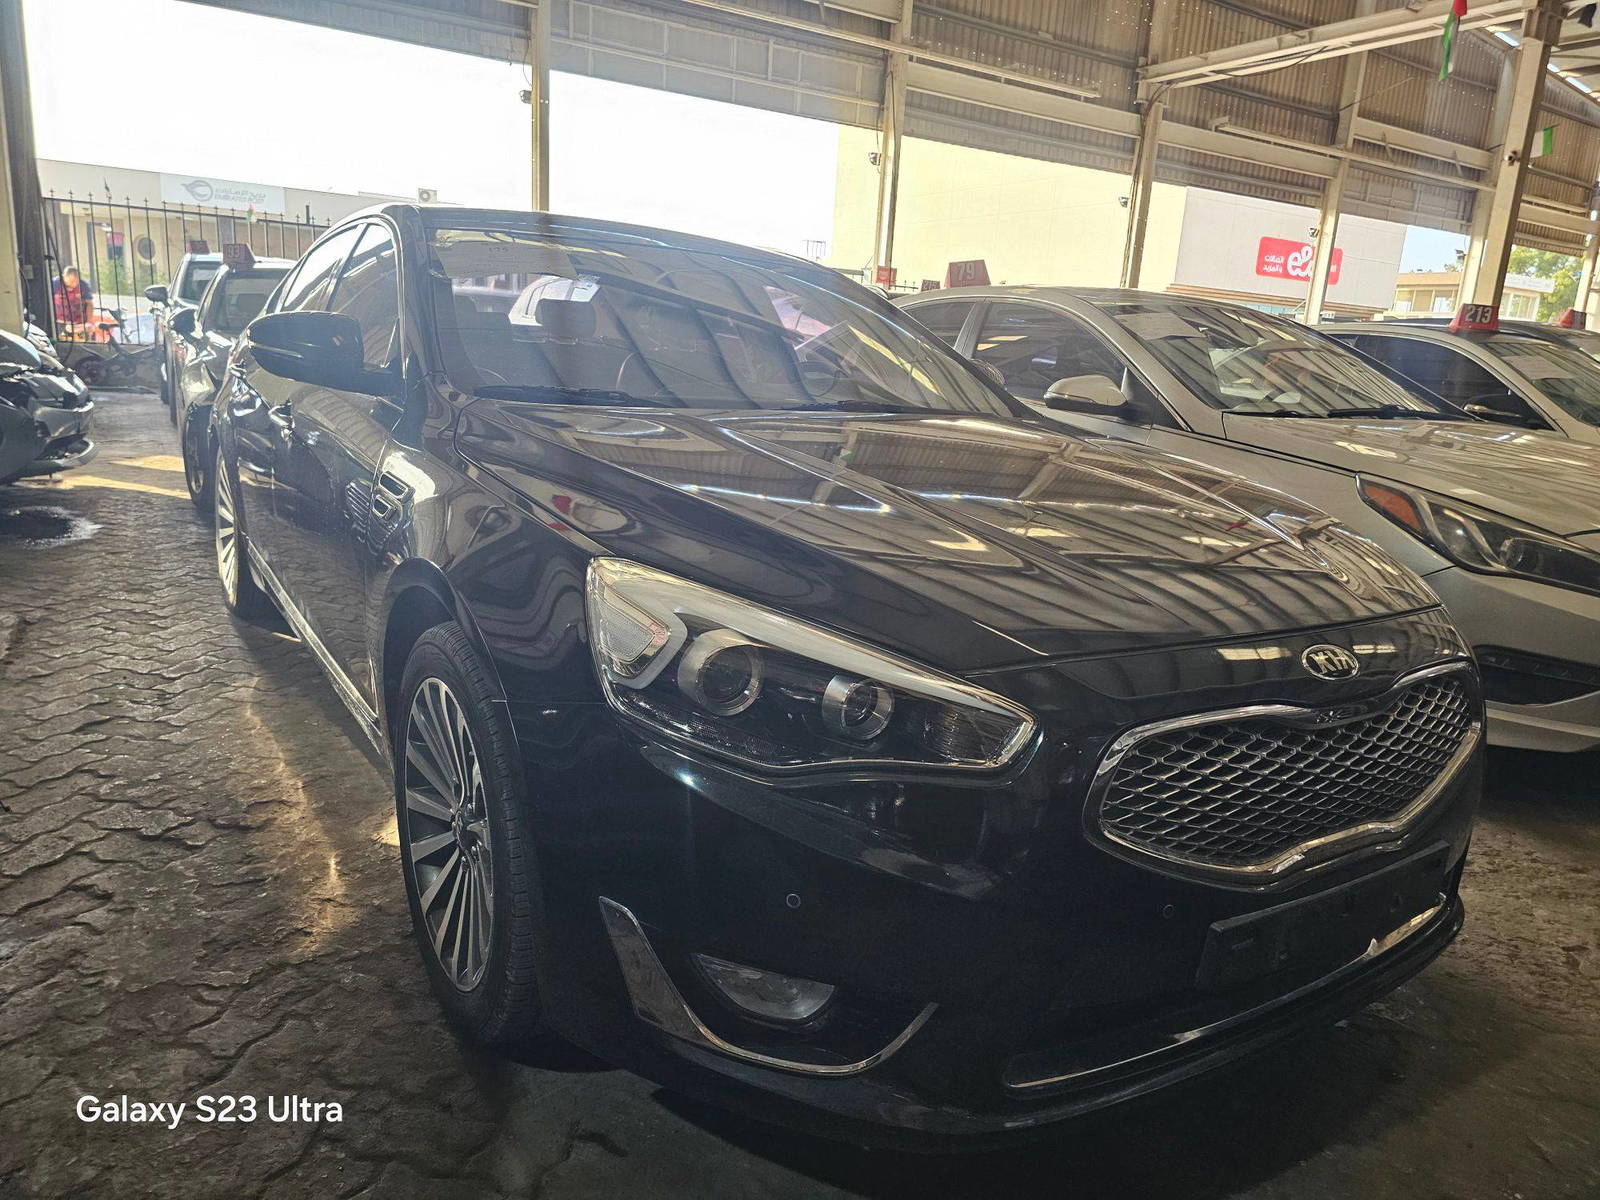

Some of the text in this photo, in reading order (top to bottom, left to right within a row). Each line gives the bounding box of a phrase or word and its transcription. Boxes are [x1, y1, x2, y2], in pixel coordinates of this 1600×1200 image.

[957, 263, 975, 280] 79
[1465, 306, 1492, 323] 213
[1308, 649, 1356, 674] KIA
